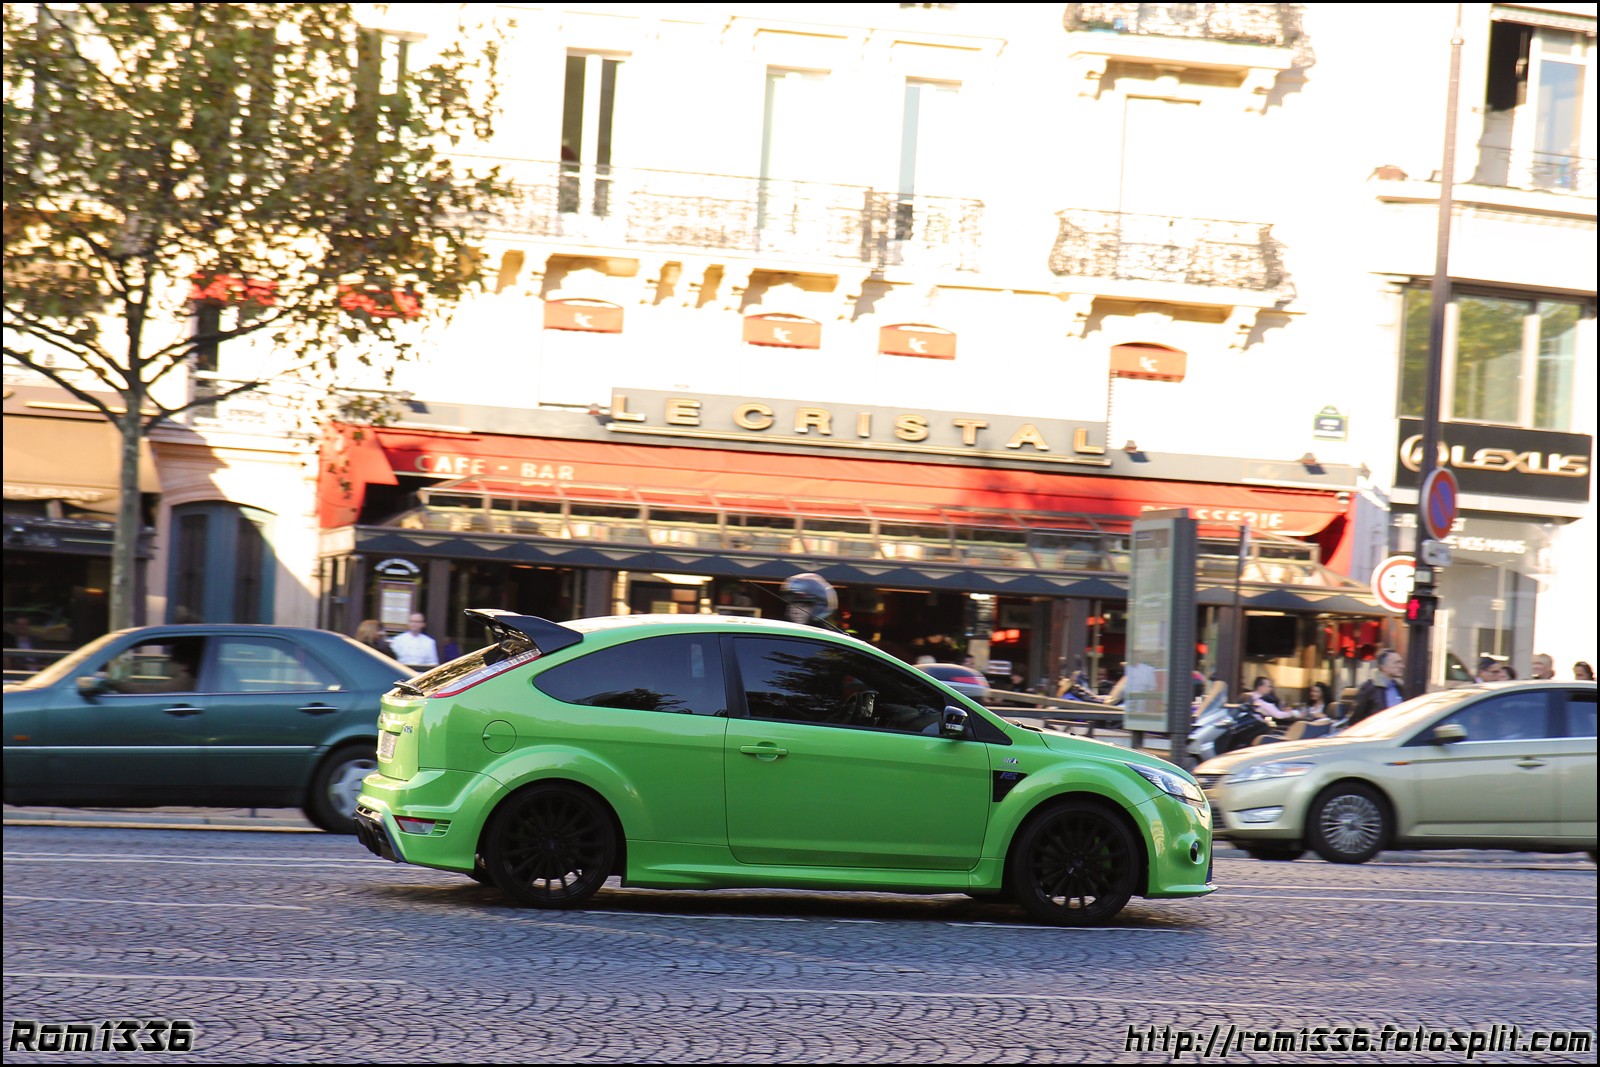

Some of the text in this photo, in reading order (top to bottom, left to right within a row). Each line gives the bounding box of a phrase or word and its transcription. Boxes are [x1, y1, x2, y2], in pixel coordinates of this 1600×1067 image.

[611, 394, 1106, 454] LE CRISTAL
[414, 455, 487, 475] CAFE
[520, 462, 575, 481] BAR
[1450, 445, 1589, 477] LEXUS
